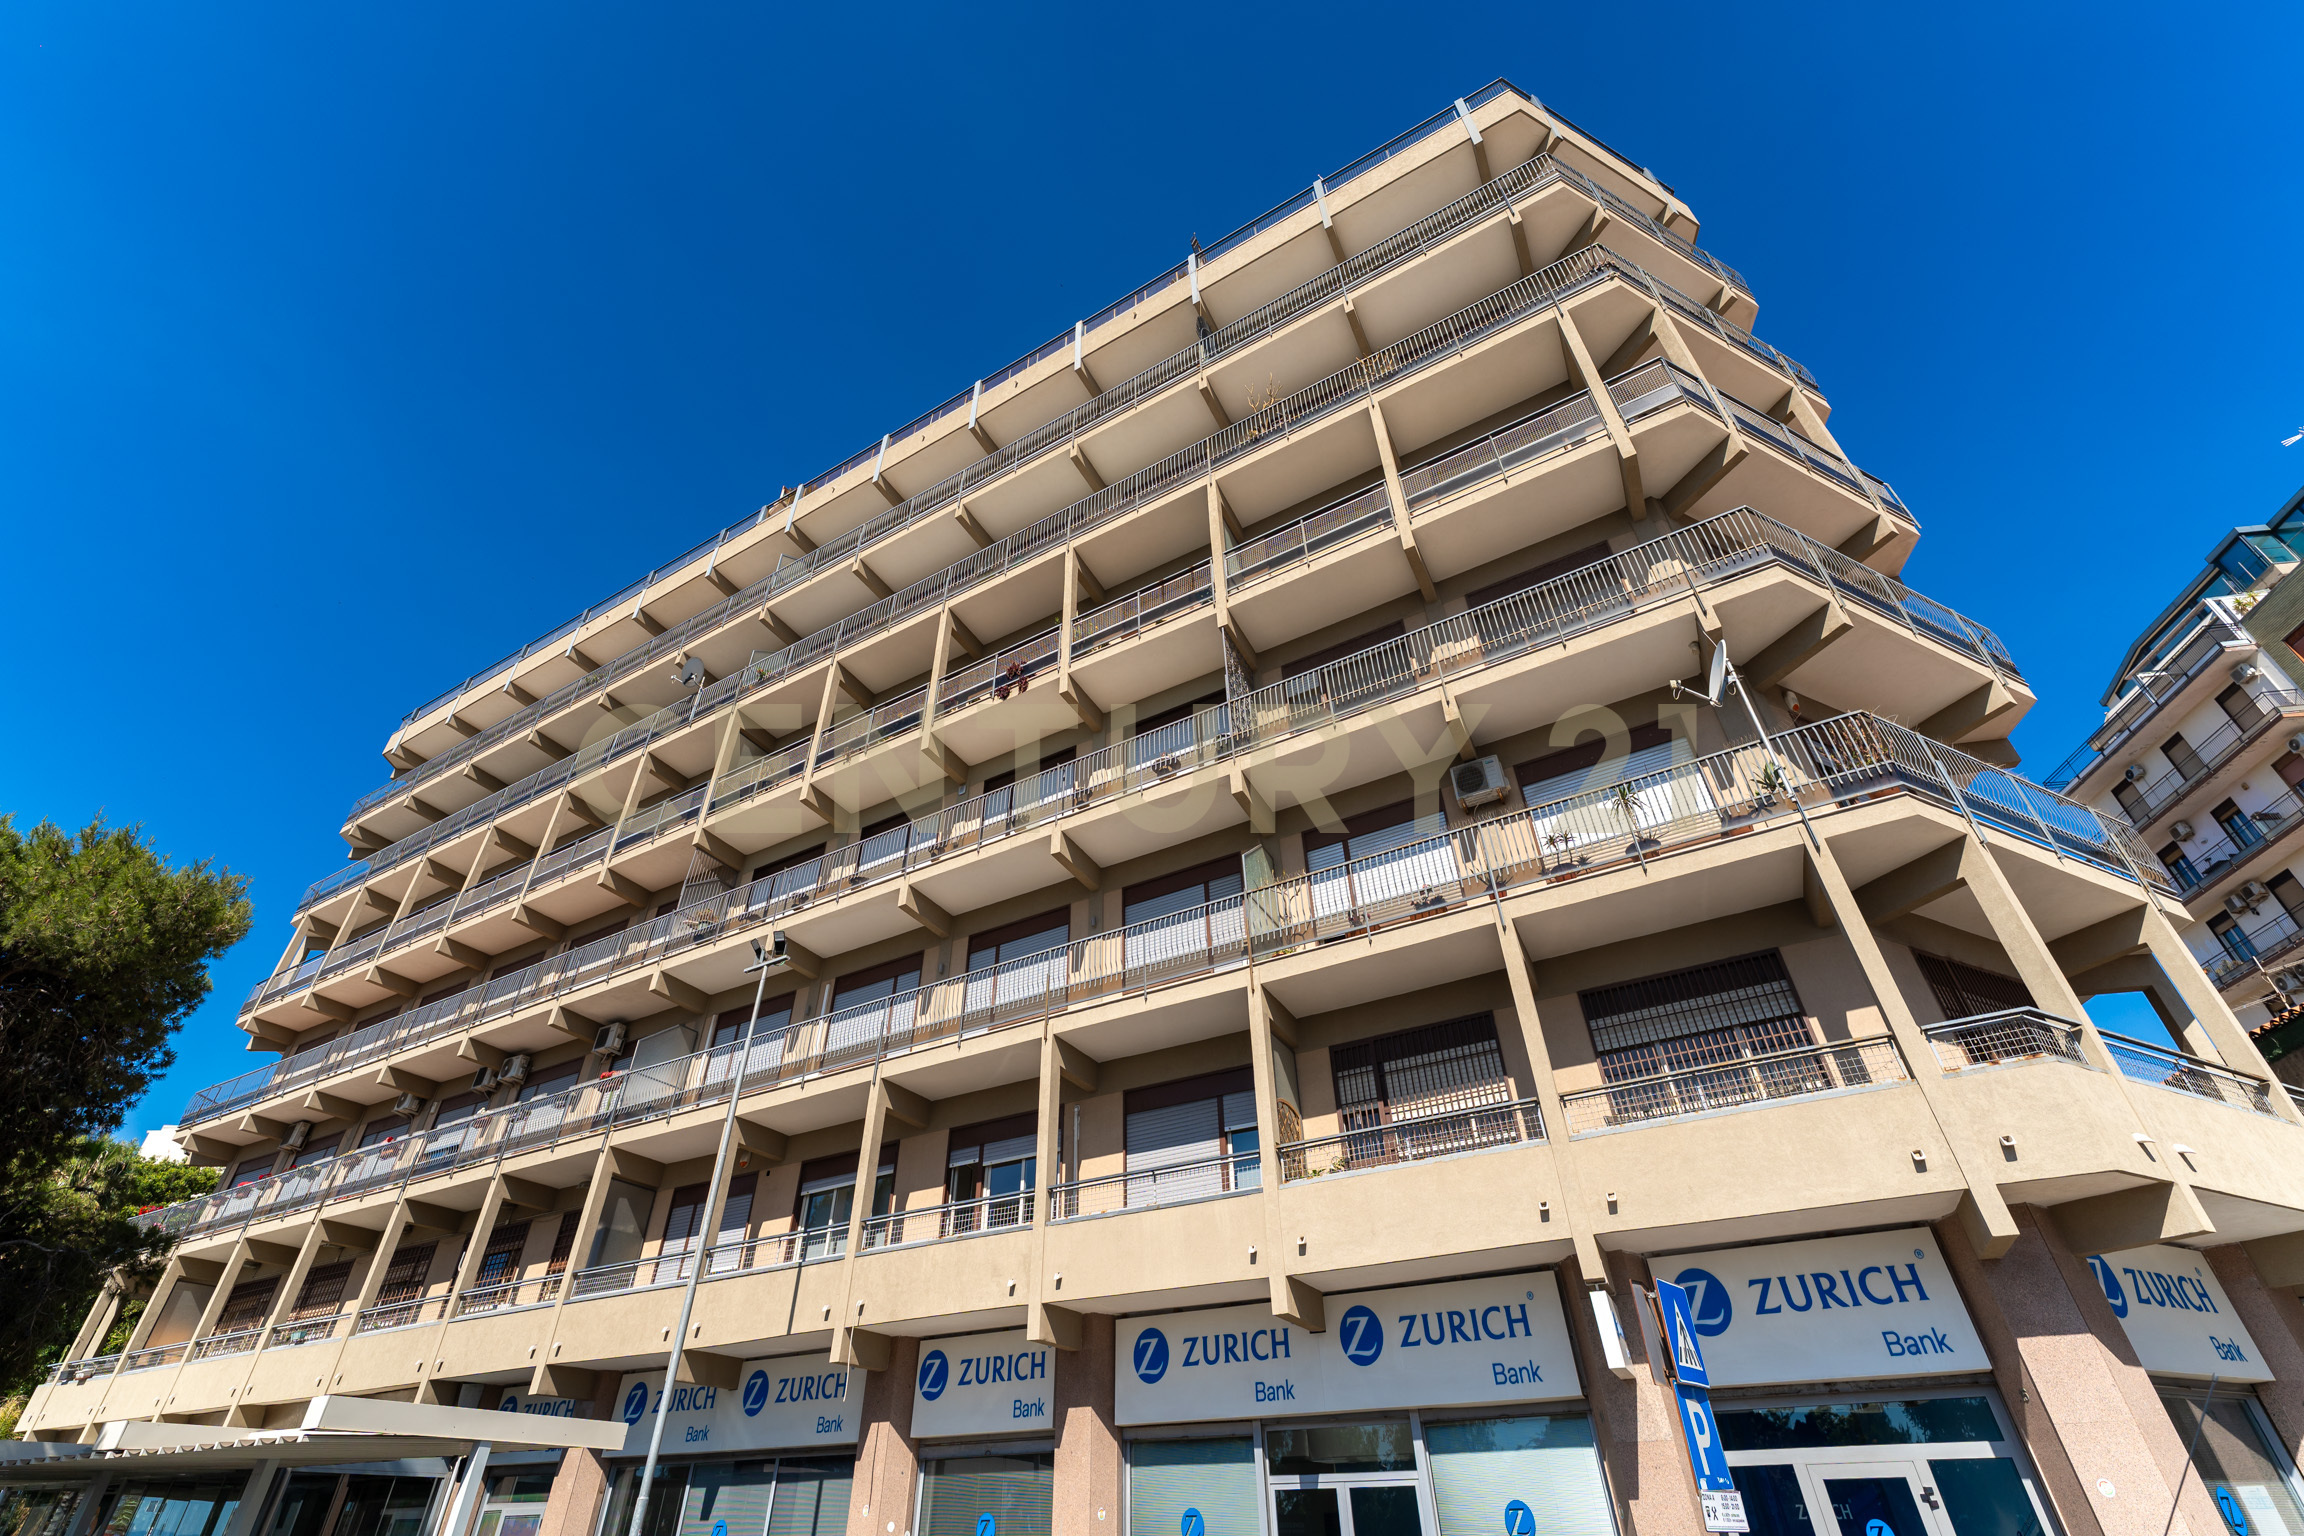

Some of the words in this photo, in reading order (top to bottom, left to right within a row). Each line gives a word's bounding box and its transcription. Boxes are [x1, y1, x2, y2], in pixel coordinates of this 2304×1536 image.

[1748, 1263, 1930, 1315] ZURICH
[2123, 1268, 2219, 1314] ZURICH
[1398, 1303, 1533, 1348] ZURICH
[1182, 1327, 1291, 1367] ZURICH
[1882, 1327, 1955, 1357] Bank
[2209, 1336, 2248, 1362] Bank
[957, 1351, 1046, 1387] ZURICH
[1492, 1360, 1544, 1385] Bank
[775, 1373, 848, 1403] ZURICH
[1255, 1379, 1295, 1402] Bank
[1013, 1397, 1045, 1419] Bank
[685, 1425, 710, 1442] Bank
[816, 1415, 844, 1433] Bank
[1685, 1399, 1711, 1475] P
